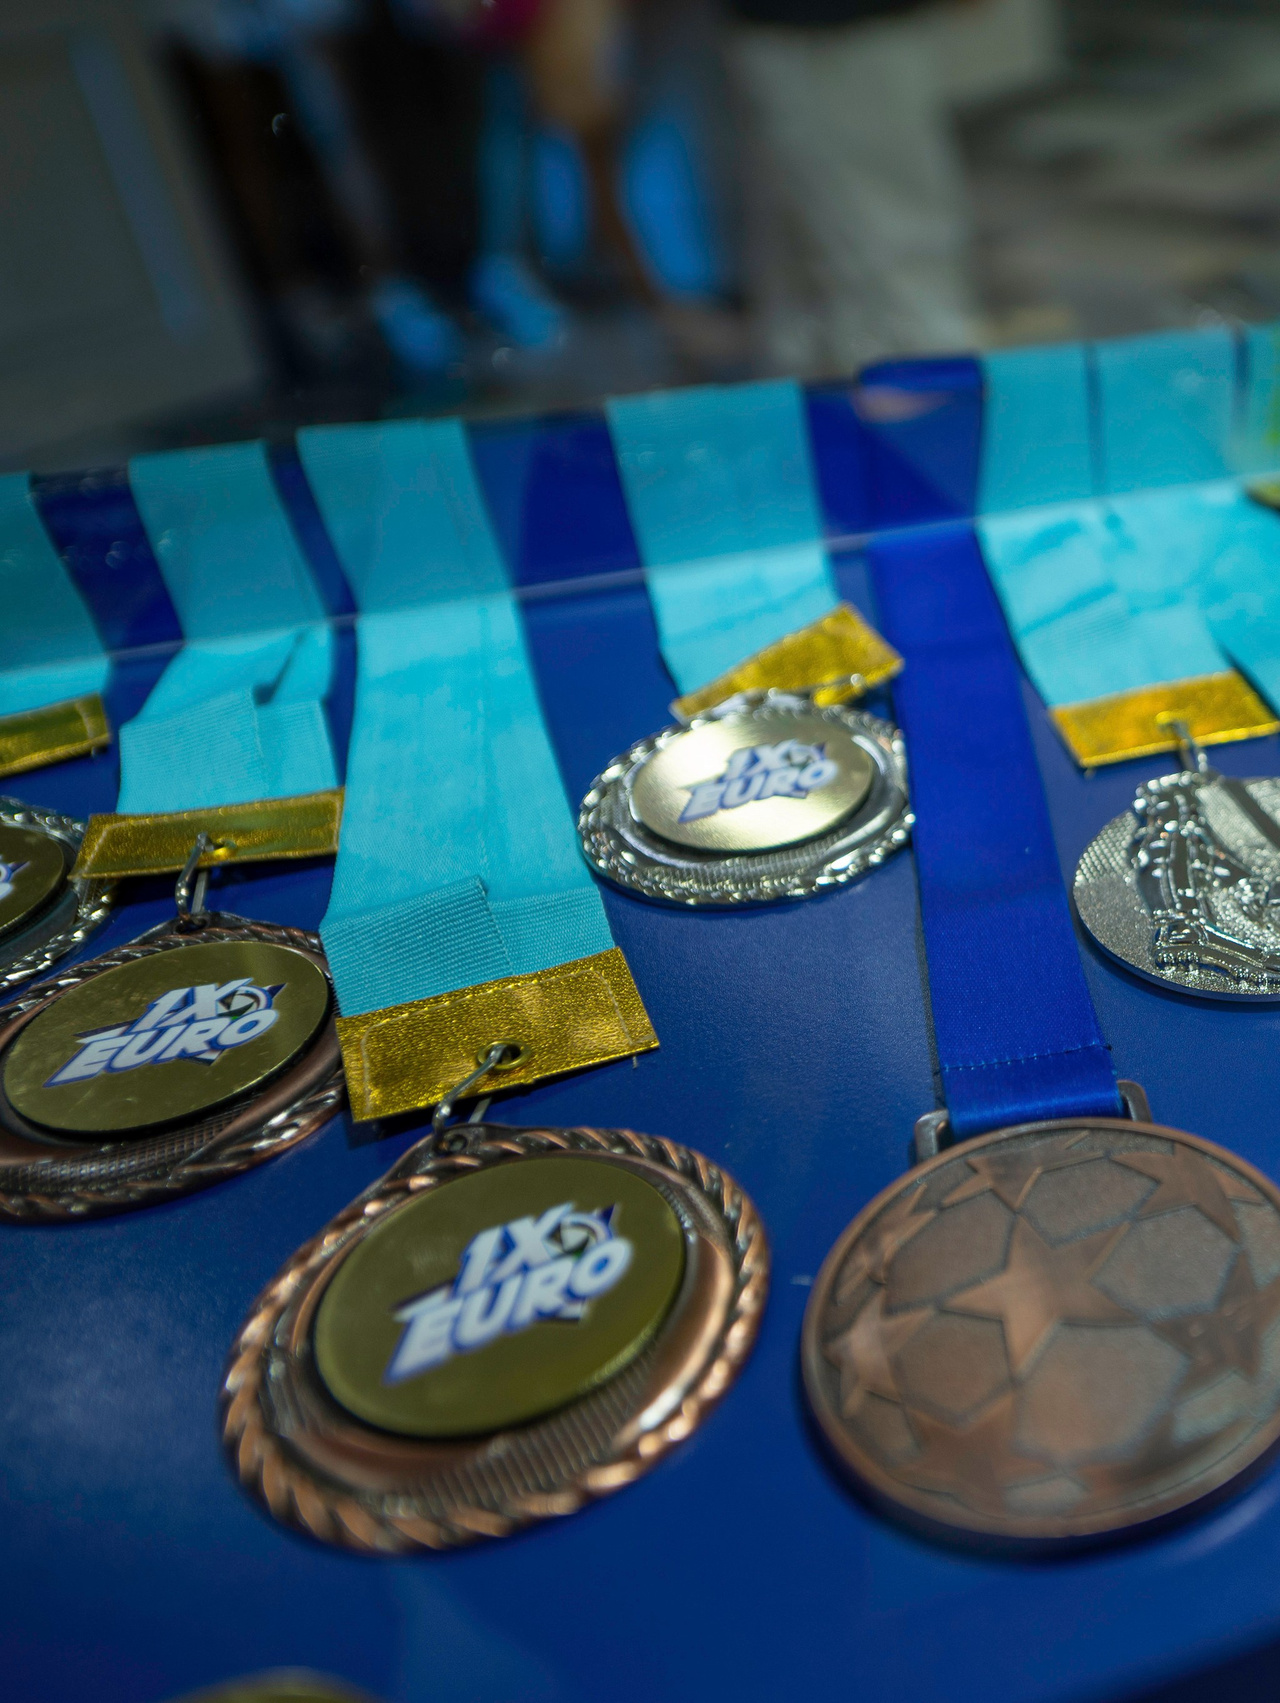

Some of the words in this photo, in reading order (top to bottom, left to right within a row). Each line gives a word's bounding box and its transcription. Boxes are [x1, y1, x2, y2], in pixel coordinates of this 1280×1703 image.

[678, 758, 839, 824] EURO
[43, 1008, 279, 1088] EURO
[380, 1236, 634, 1386] EURO
